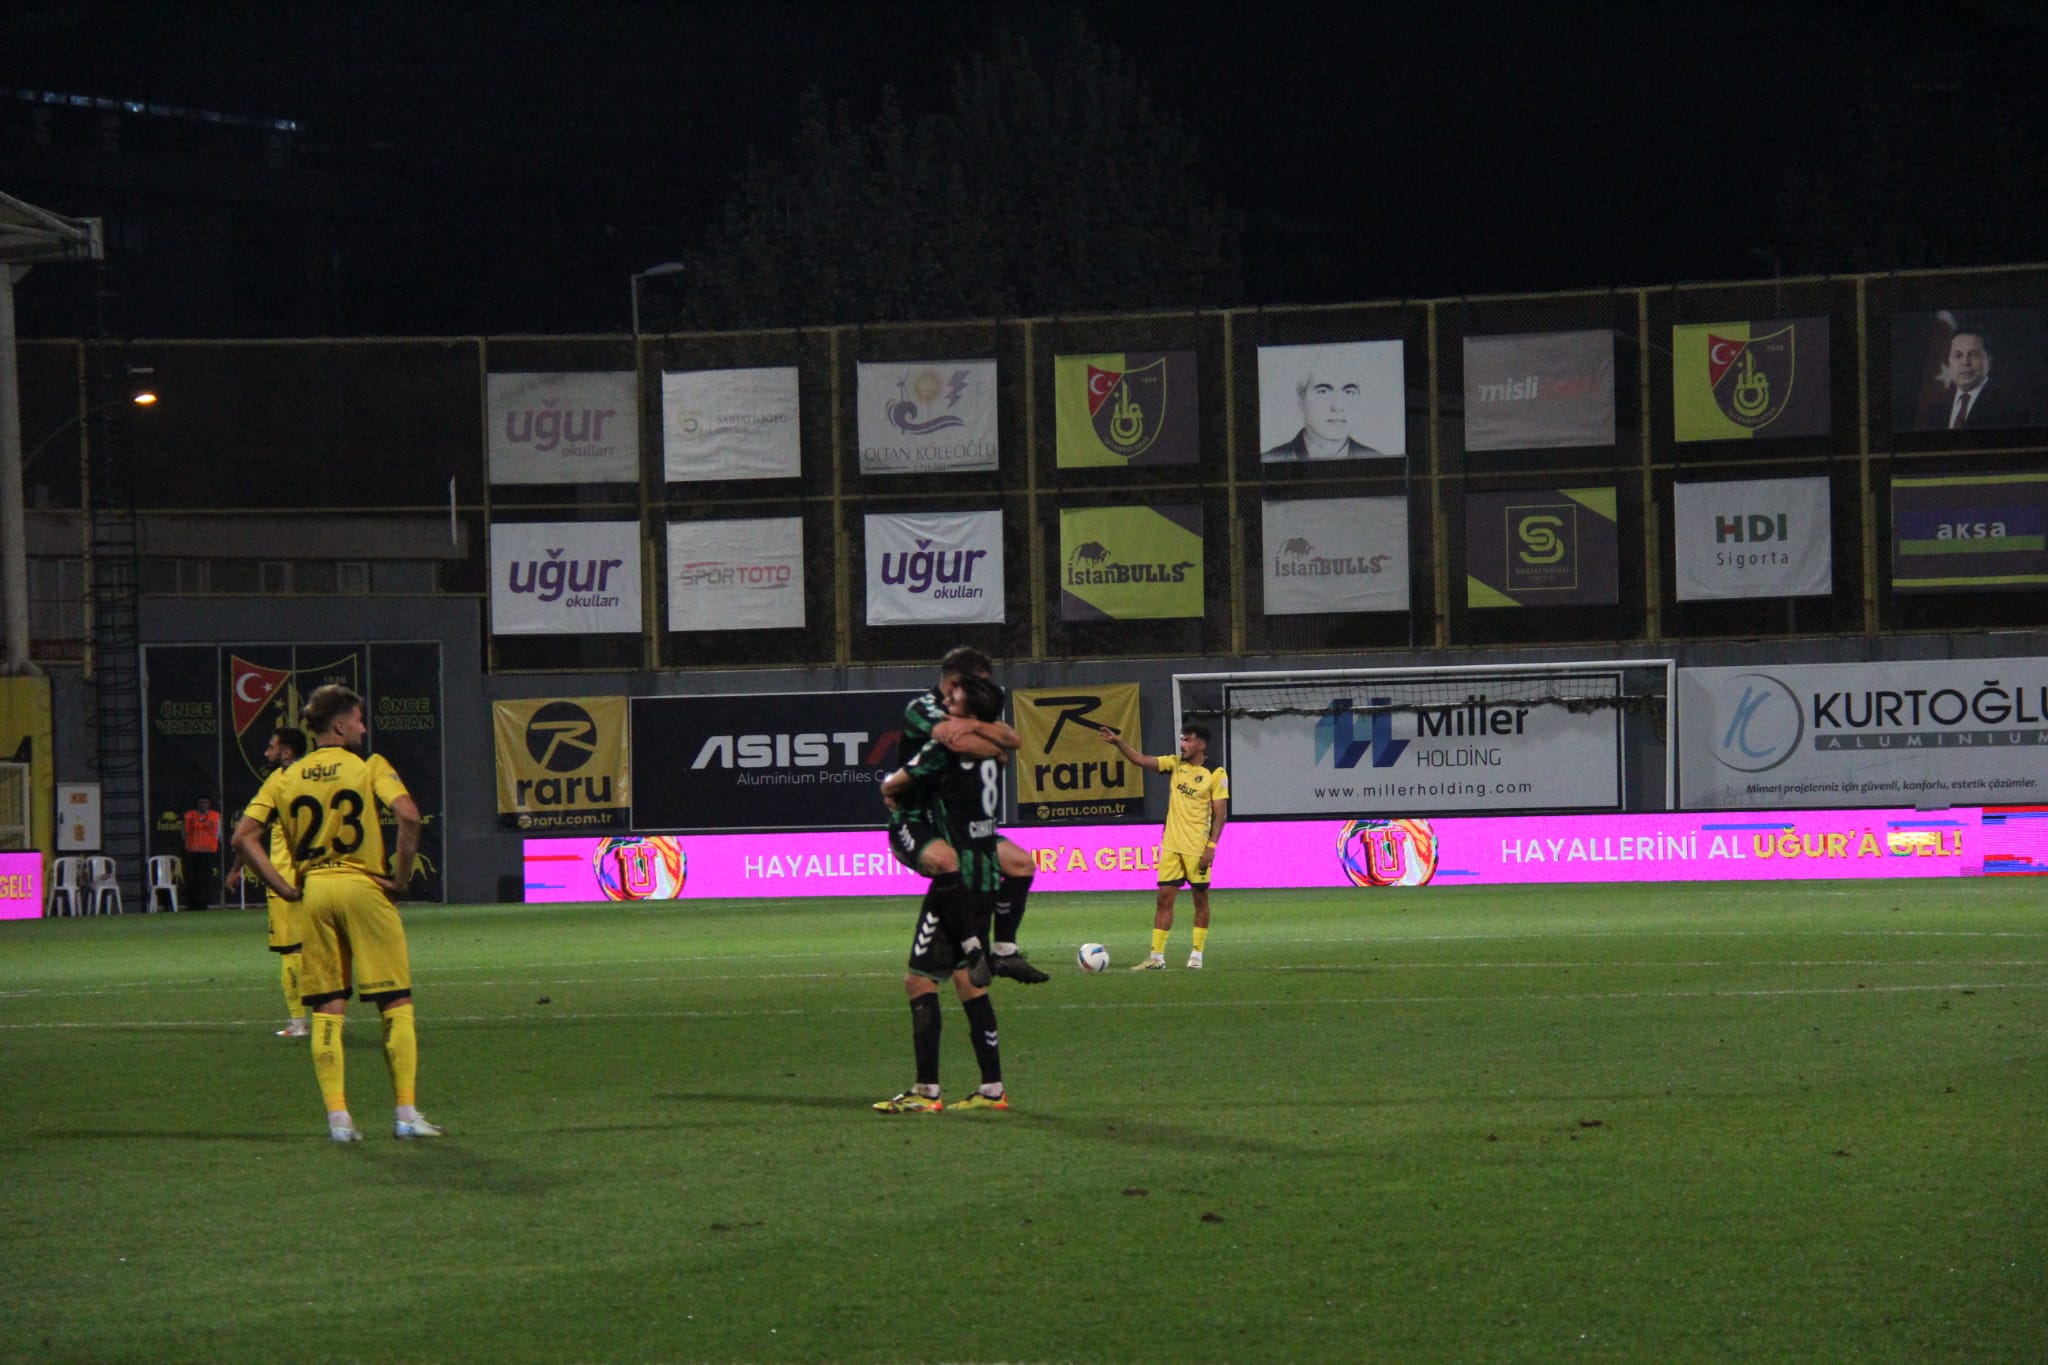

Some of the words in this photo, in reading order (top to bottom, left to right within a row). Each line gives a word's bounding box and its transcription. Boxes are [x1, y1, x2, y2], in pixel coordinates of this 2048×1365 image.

[1478, 376, 1539, 402] misli
[506, 399, 616, 451] uğur
[562, 443, 615, 457] okulları
[864, 446, 910, 462] OLTAN
[1715, 513, 1787, 543] HDI
[1936, 521, 2006, 540] aksa
[881, 539, 988, 593] uğur
[1274, 554, 1392, 576] İstanBULLS
[1716, 552, 1789, 569] Sigorta
[509, 548, 624, 602] uğur
[1067, 561, 1195, 585] İstanBULLS
[566, 594, 619, 607] okulları
[934, 586, 984, 599] okulları
[160, 700, 212, 718] ÖNCE
[378, 695, 430, 713] ÖNCE
[1814, 680, 2048, 728] KURTOĞL
[374, 714, 434, 731] VATAN
[1417, 694, 1529, 737] Miller
[155, 719, 216, 736] VATAN
[1417, 745, 1502, 768] HOLDİNG
[301, 763, 341, 781] uğur
[737, 771, 815, 785] Aluminium
[819, 769, 872, 784] Profiles
[1035, 761, 1125, 791] raru
[517, 776, 611, 806] raru
[980, 759, 998, 817] 8
[1314, 782, 1533, 798] www.millerholding.com
[1746, 784, 1782, 793] Mimari
[1783, 782, 1840, 794] projeleriniz
[1842, 781, 1859, 793] için
[1860, 780, 1901, 793] güvenli,
[1903, 779, 1950, 792] konforlu,
[1952, 778, 1986, 789] estetik
[533, 813, 612, 826] raru.com.tr
[1051, 803, 1126, 817] raru.com.tr
[290, 788, 364, 861] 23
[1501, 831, 1697, 863] HAYALLERİNİ
[1707, 834, 1747, 860] AL
[1753, 826, 1882, 858] UĞUR'A
[1095, 845, 1161, 871] GEL!
